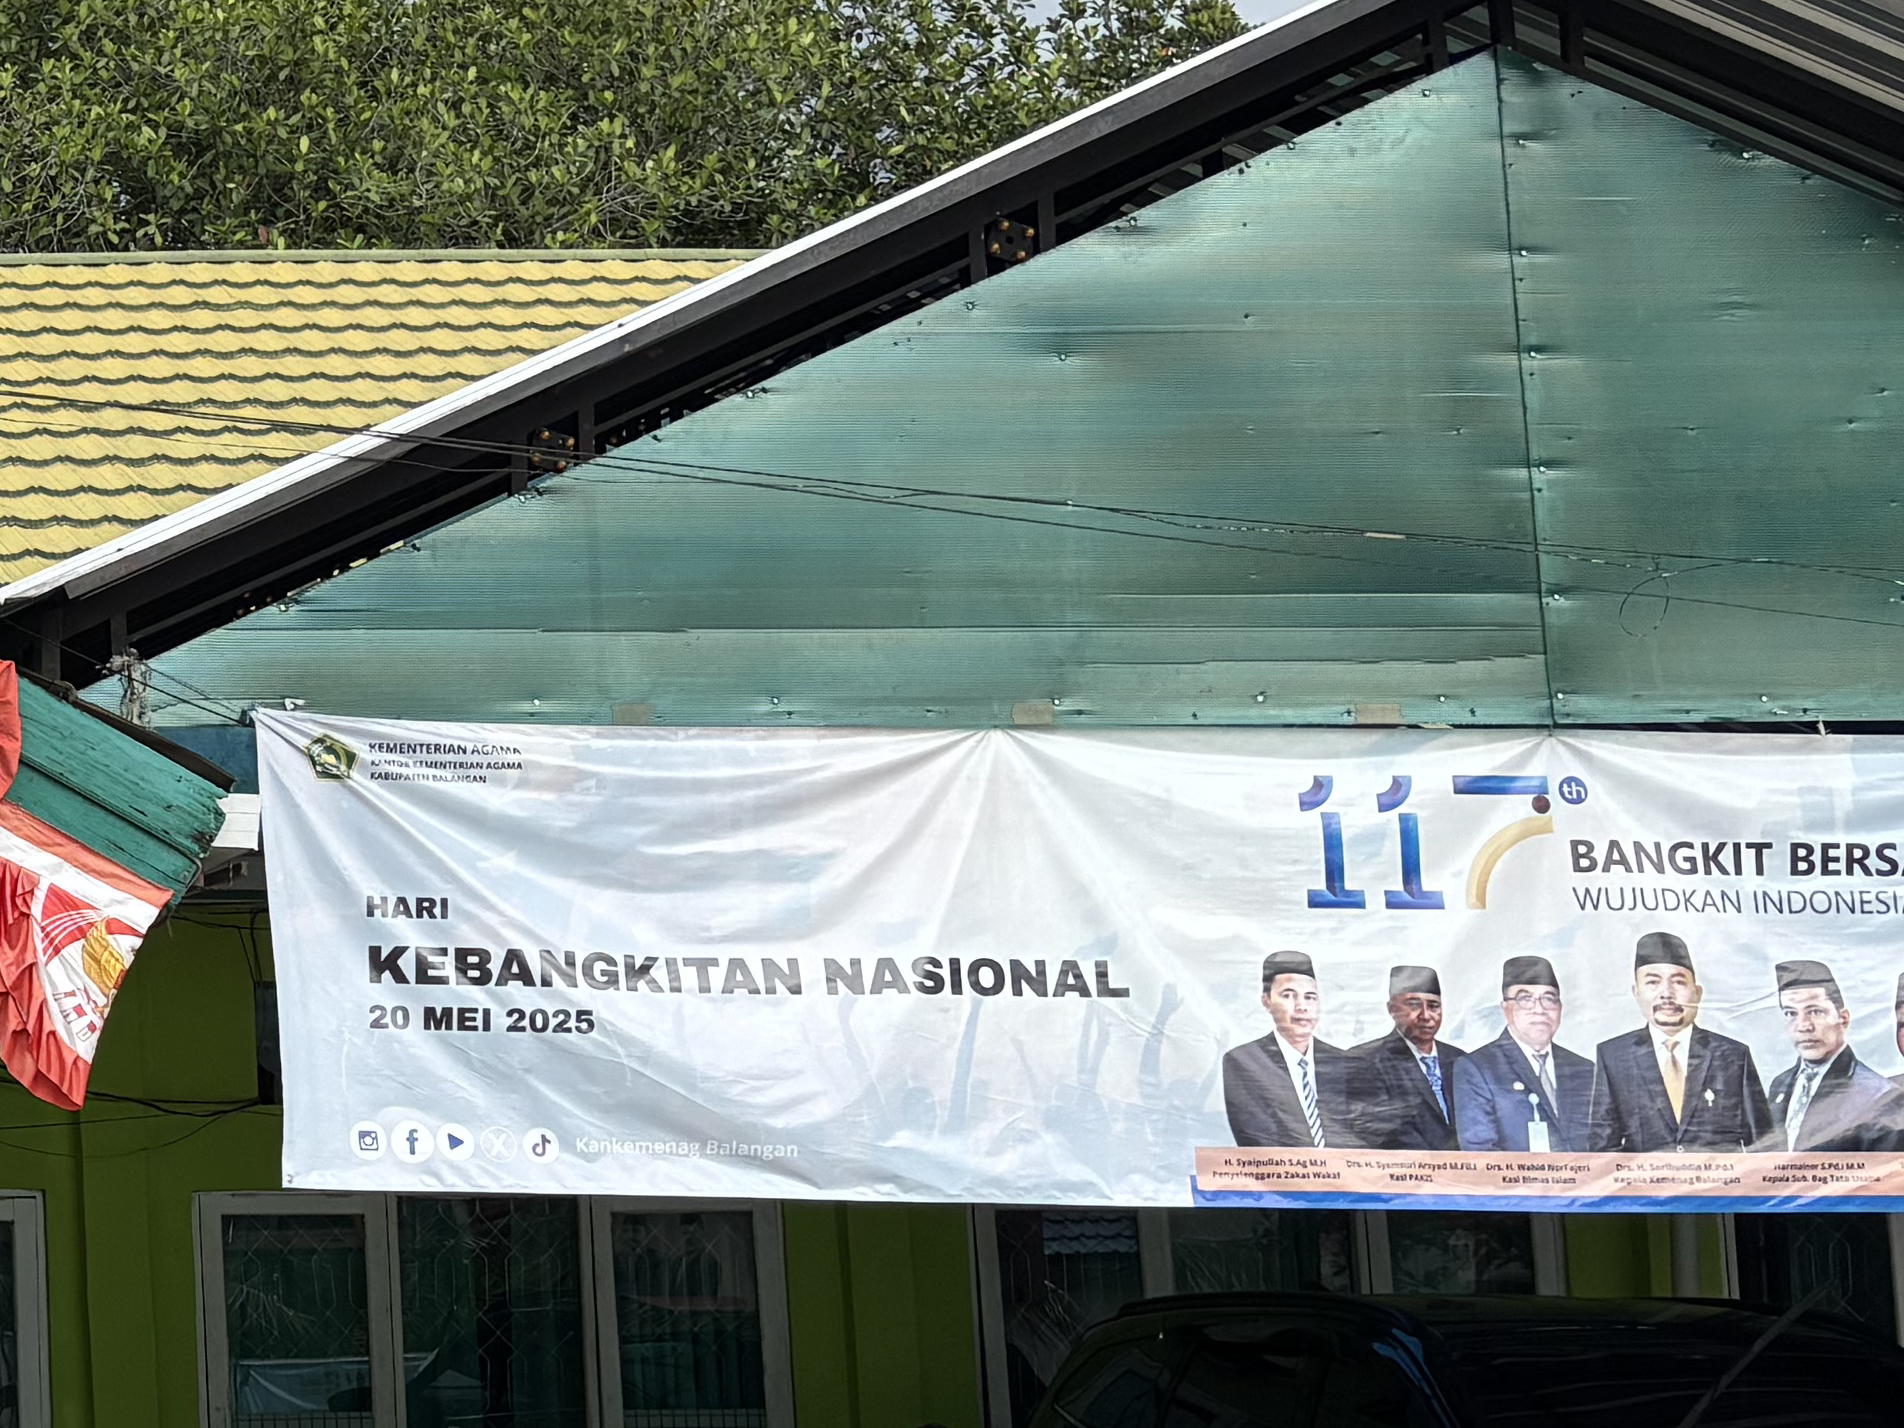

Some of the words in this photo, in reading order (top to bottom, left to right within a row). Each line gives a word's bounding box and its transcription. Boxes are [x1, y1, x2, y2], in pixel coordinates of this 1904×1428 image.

[369, 742, 467, 755] KEMENTERIAN
[486, 761, 523, 770] AGAMA
[1298, 775, 1554, 910] 117
[1570, 839, 1773, 876] BANGKIT
[1791, 842, 1904, 877] BERS
[366, 896, 449, 920] HARI
[1572, 886, 1743, 913] WUJUDKAN
[368, 945, 802, 996] KEBANGKITAN
[825, 956, 1131, 999] NASIONAL
[368, 1005, 410, 1031] 20
[423, 1006, 492, 1033] MEI
[505, 1008, 596, 1035] 2025
[576, 1136, 700, 1158] Kankemenag
[706, 1140, 799, 1160] Balangan
